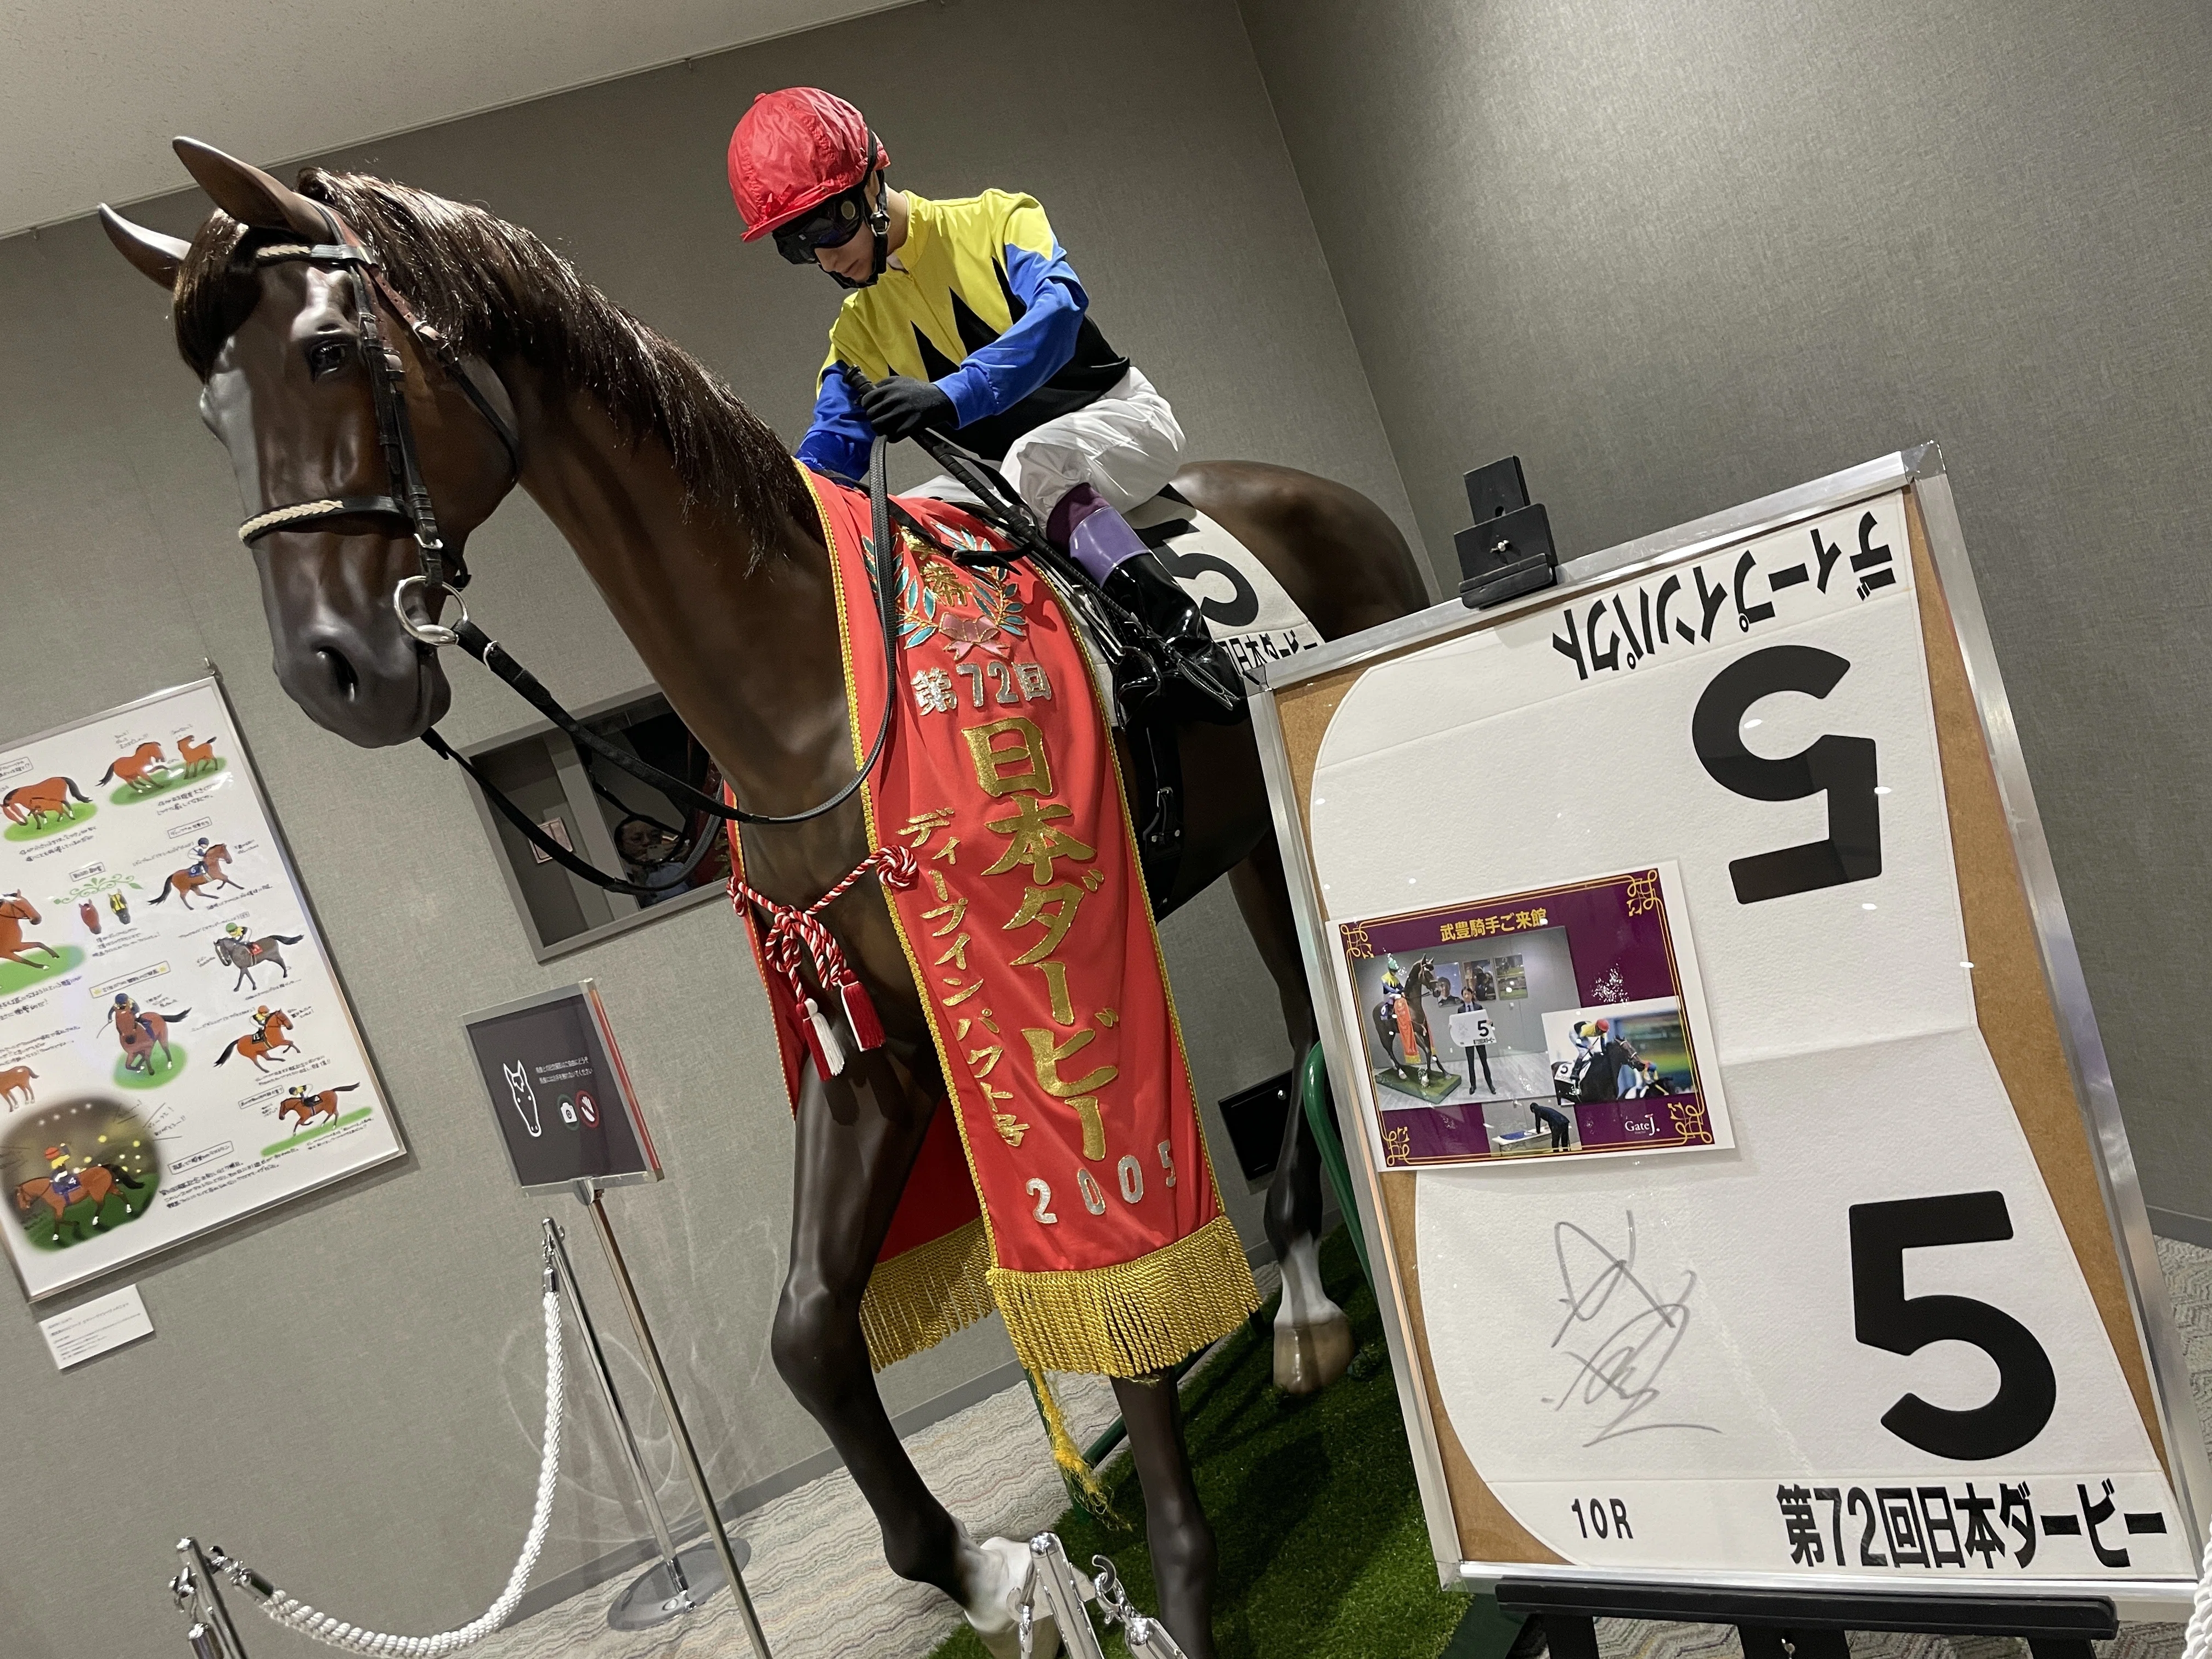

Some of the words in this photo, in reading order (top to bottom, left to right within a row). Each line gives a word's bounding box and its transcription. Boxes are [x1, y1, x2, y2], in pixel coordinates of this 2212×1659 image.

[1134, 518, 1259, 627] 5
[1552, 511, 1897, 680] ディープインパクト
[910, 661, 1052, 716] 第72回
[1692, 645, 1882, 904] 5
[961, 716, 1120, 1161] 日本ダービー
[1440, 907, 1547, 941] 武豊騎手ご来館
[895, 808, 1030, 1147] ディープインパクト号
[1477, 1019, 1489, 1037] 5
[1026, 1140, 1177, 1224] 2005
[1849, 1190, 2057, 1460] 5
[1571, 1498, 1634, 1540] 10R
[1776, 1478, 2167, 1569] 第72回日本ダービー
